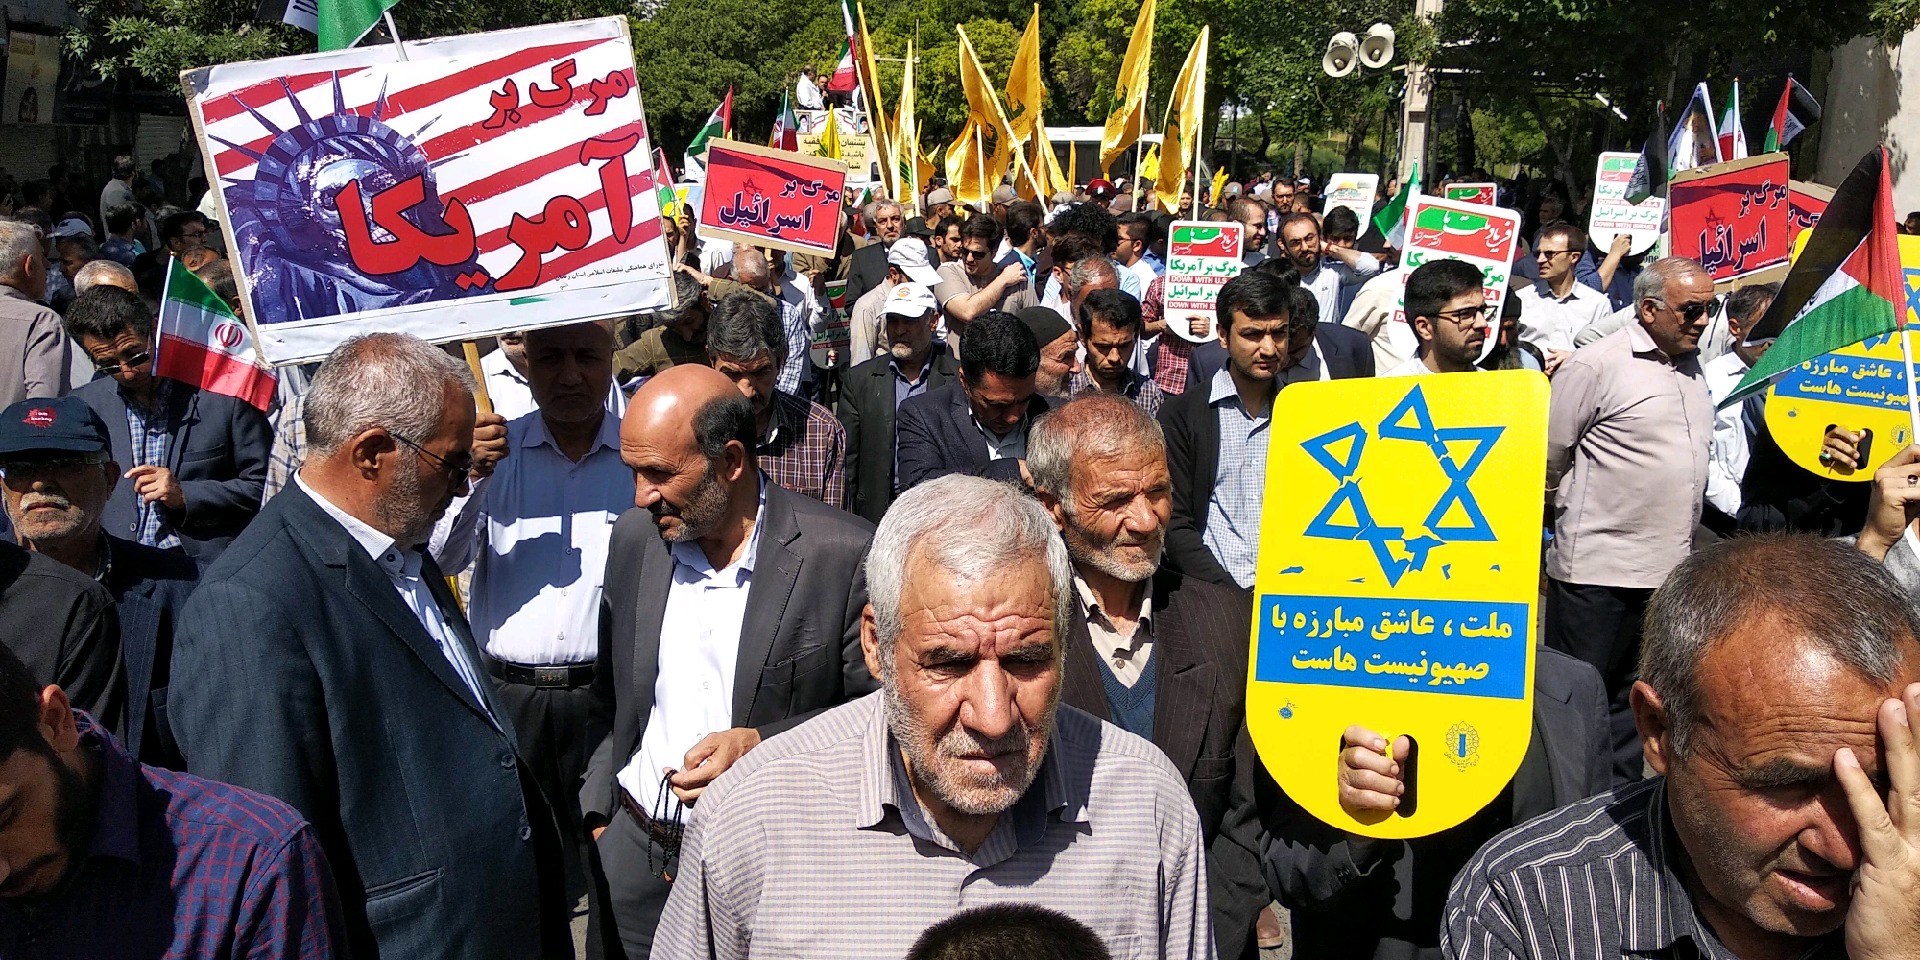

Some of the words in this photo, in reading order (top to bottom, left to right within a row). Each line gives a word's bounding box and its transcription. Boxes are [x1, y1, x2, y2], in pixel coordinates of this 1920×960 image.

[529, 59, 629, 115] مرگ
[482, 78, 521, 129] بر
[780, 180, 797, 198] بر
[801, 180, 840, 205] مرگ
[1598, 185, 1623, 198] مریکا
[1753, 179, 1787, 210] مرگ
[335, 132, 639, 291] آمریکا
[719, 191, 813, 234] اسرائیل
[1738, 190, 1750, 218] بر
[1170, 258, 1205, 275] آمریکا
[1203, 263, 1213, 276] بر
[1215, 261, 1238, 276] مرگ
[1167, 284, 1204, 299] اسرائیل
[1203, 288, 1213, 300] بر
[1802, 358, 1848, 377] مبارزه
[1852, 363, 1892, 380] عاشق
[1799, 380, 1842, 396] هاست
[1846, 386, 1914, 406] هیونیست
[1272, 604, 1287, 635] با
[1293, 606, 1364, 637] مبارزه
[1371, 609, 1434, 640] عاشق
[1460, 612, 1512, 639] ملت
[1291, 645, 1357, 672] هاست
[1364, 651, 1490, 686] صهیونیست
